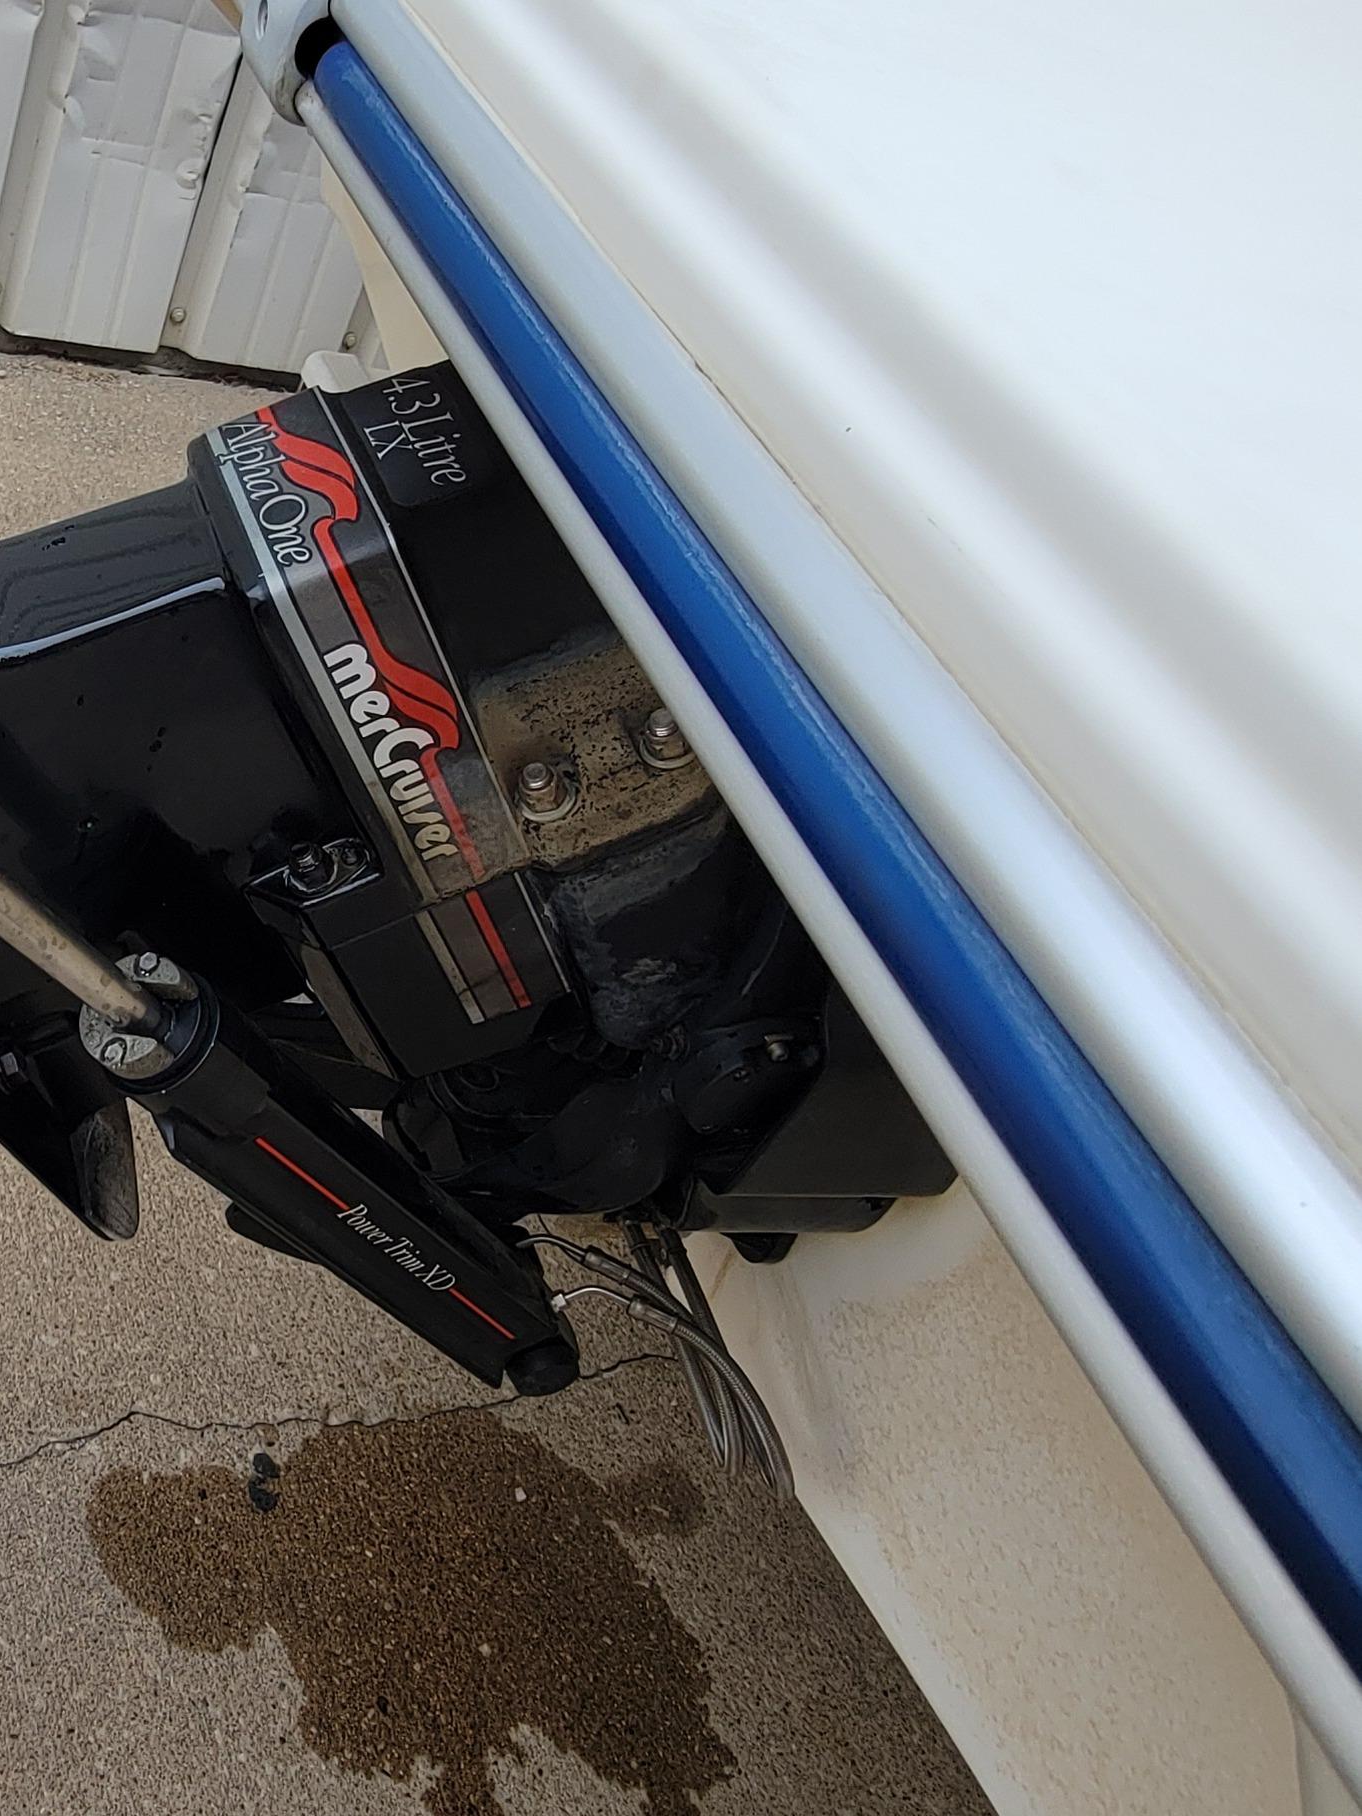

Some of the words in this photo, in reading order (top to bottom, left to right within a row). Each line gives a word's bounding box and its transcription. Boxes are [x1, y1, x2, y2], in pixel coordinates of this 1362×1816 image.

[363, 420, 414, 460] LX
[400, 411, 467, 486] Litre
[218, 422, 286, 501] Alpha
[258, 492, 313, 567] One
[337, 1203, 393, 1246] Power
[384, 1236, 426, 1273] Trim
[414, 1263, 457, 1291] XD
